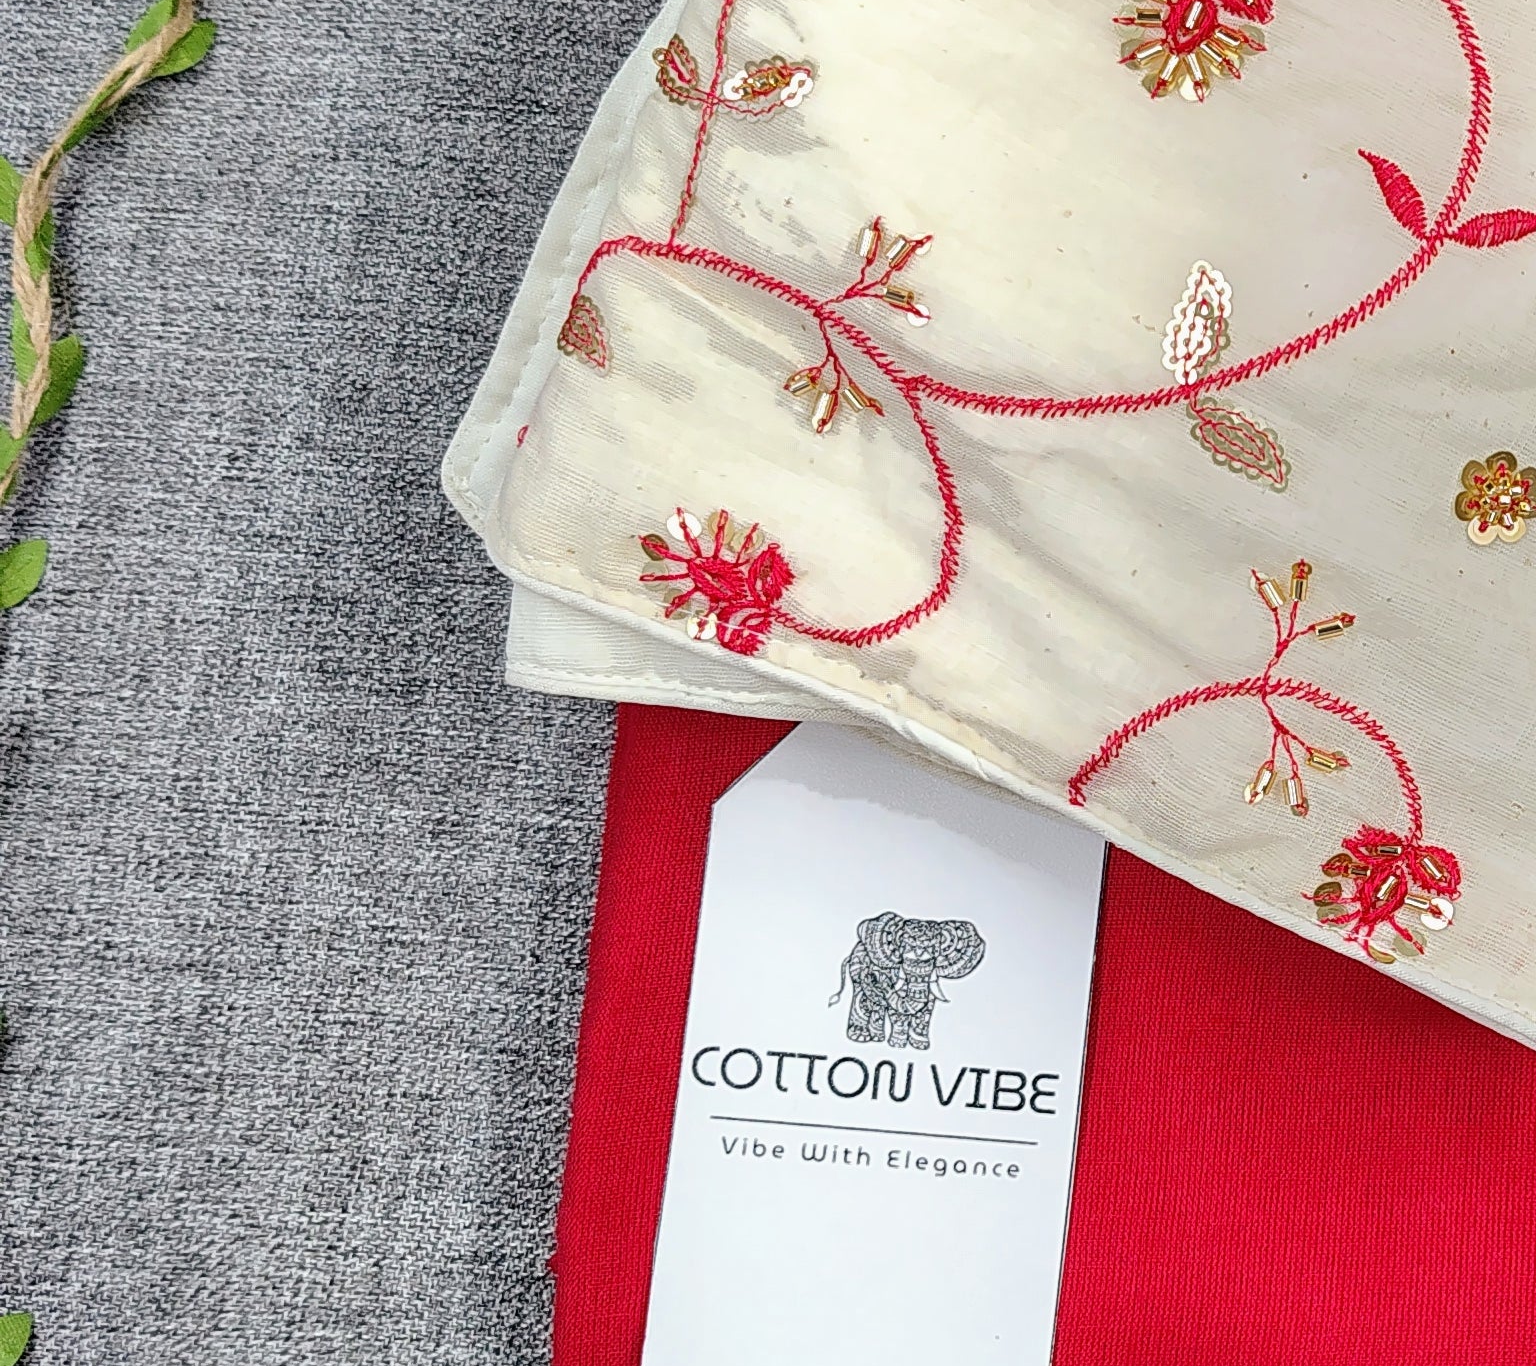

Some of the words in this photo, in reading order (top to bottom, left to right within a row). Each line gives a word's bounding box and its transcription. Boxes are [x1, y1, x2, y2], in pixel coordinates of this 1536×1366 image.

[691, 1046, 912, 1103] COTTON
[931, 1064, 1060, 1115] VIBE
[721, 1136, 785, 1160] Vibe
[801, 1144, 871, 1167] With
[886, 1149, 1021, 1178] Elegance
